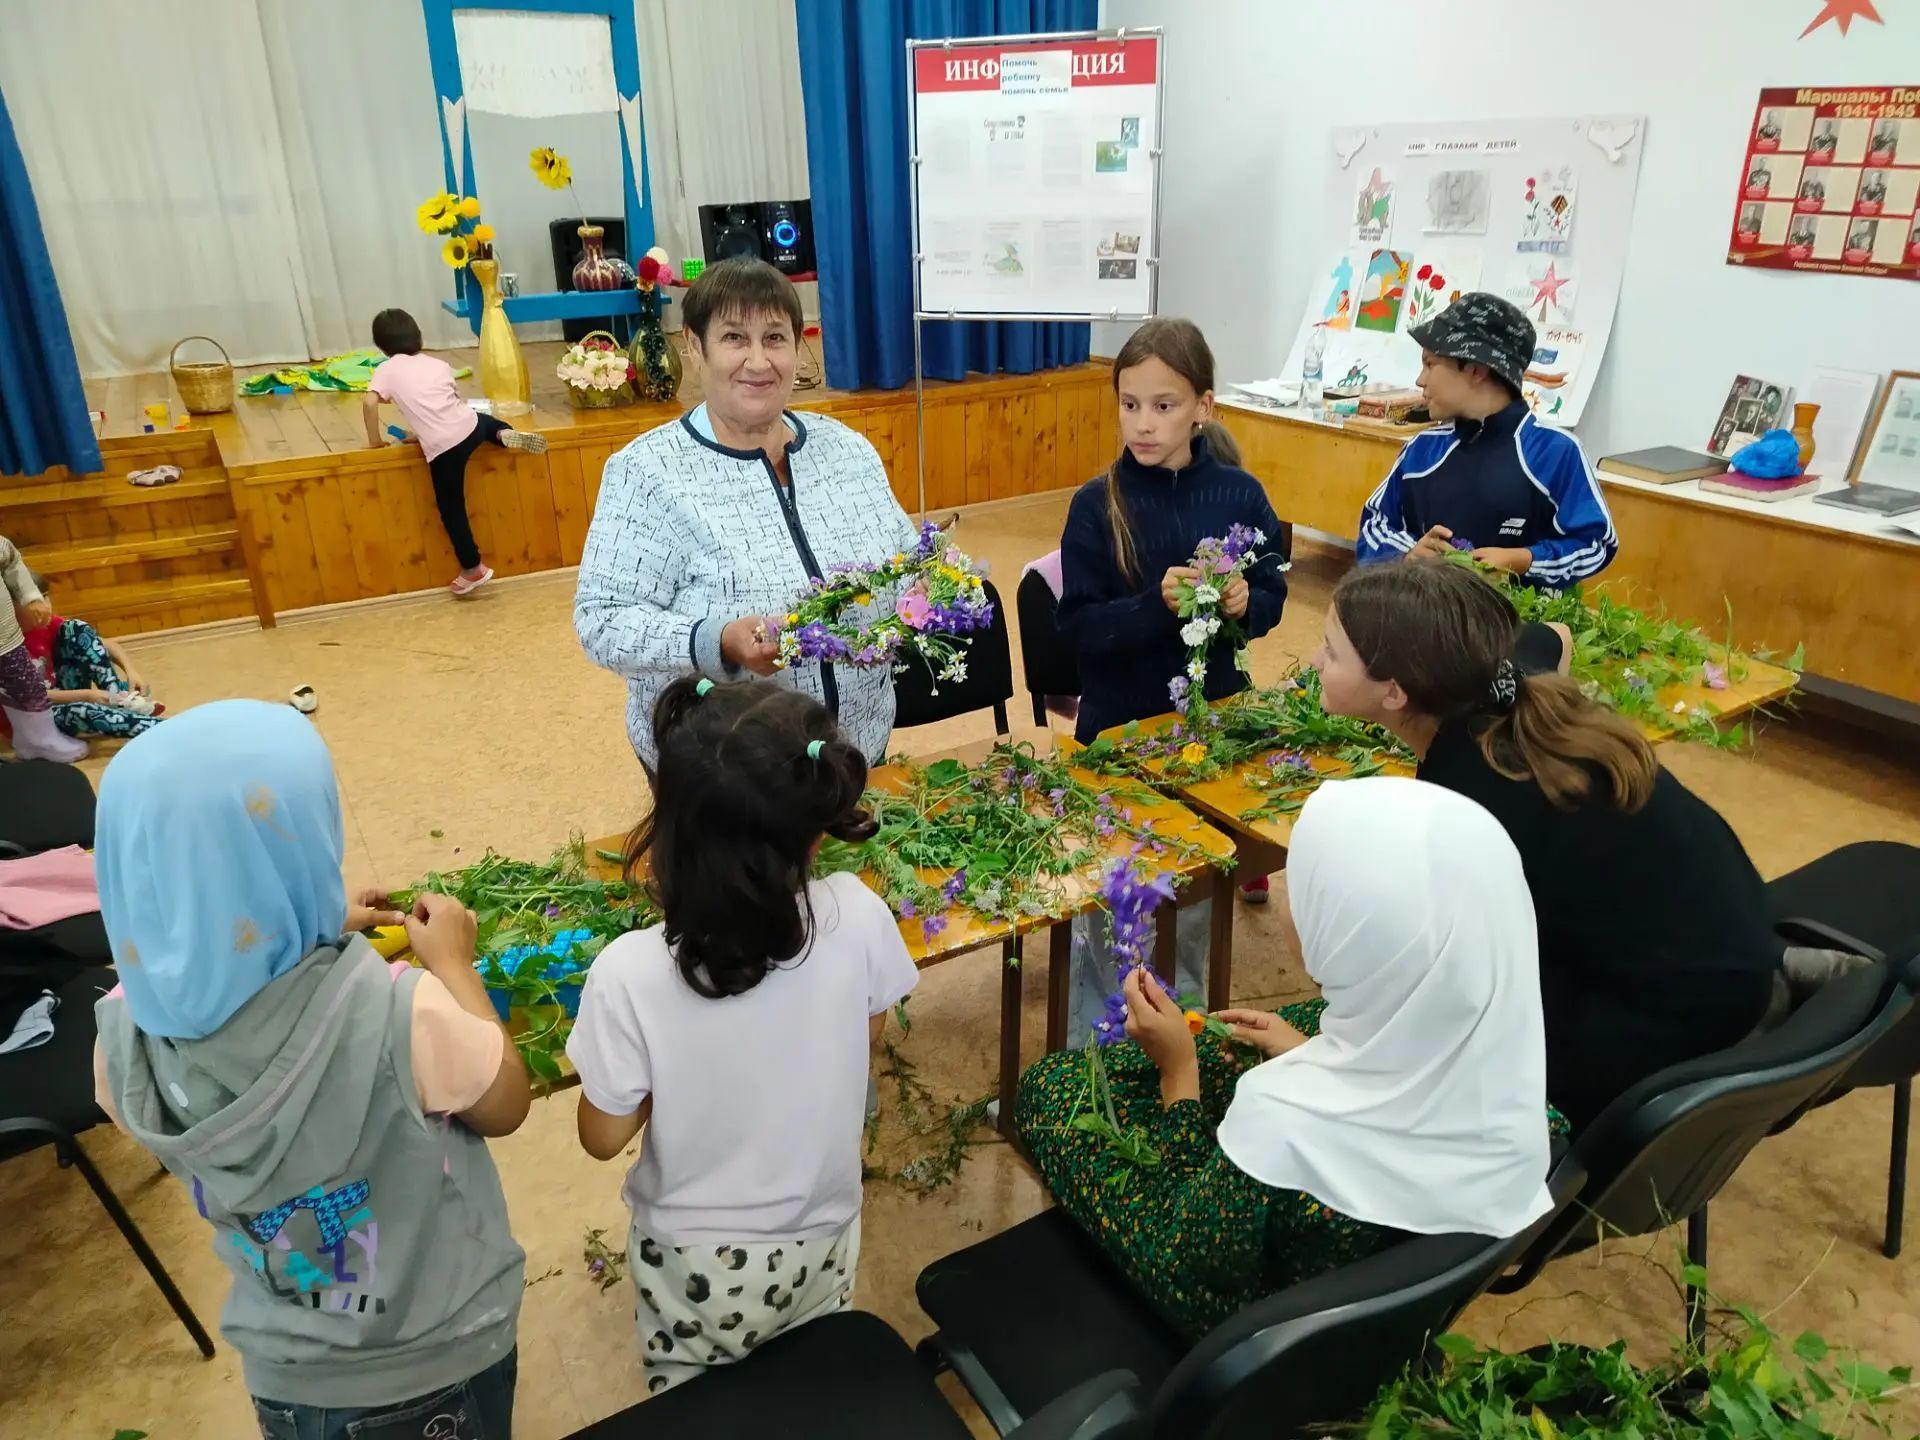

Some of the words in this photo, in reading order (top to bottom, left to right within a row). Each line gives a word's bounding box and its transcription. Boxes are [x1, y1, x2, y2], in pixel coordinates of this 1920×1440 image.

[944, 52, 1127, 81] ИНФЦИЯ
[1002, 59, 1038, 68] Помочь
[1796, 88, 1887, 106] Маршалы
[1834, 104, 1917, 118] 1941-1945
[1435, 142, 1479, 150] ГЛАЗАМИ
[1486, 139, 1517, 150] ДЕТЕЙ
